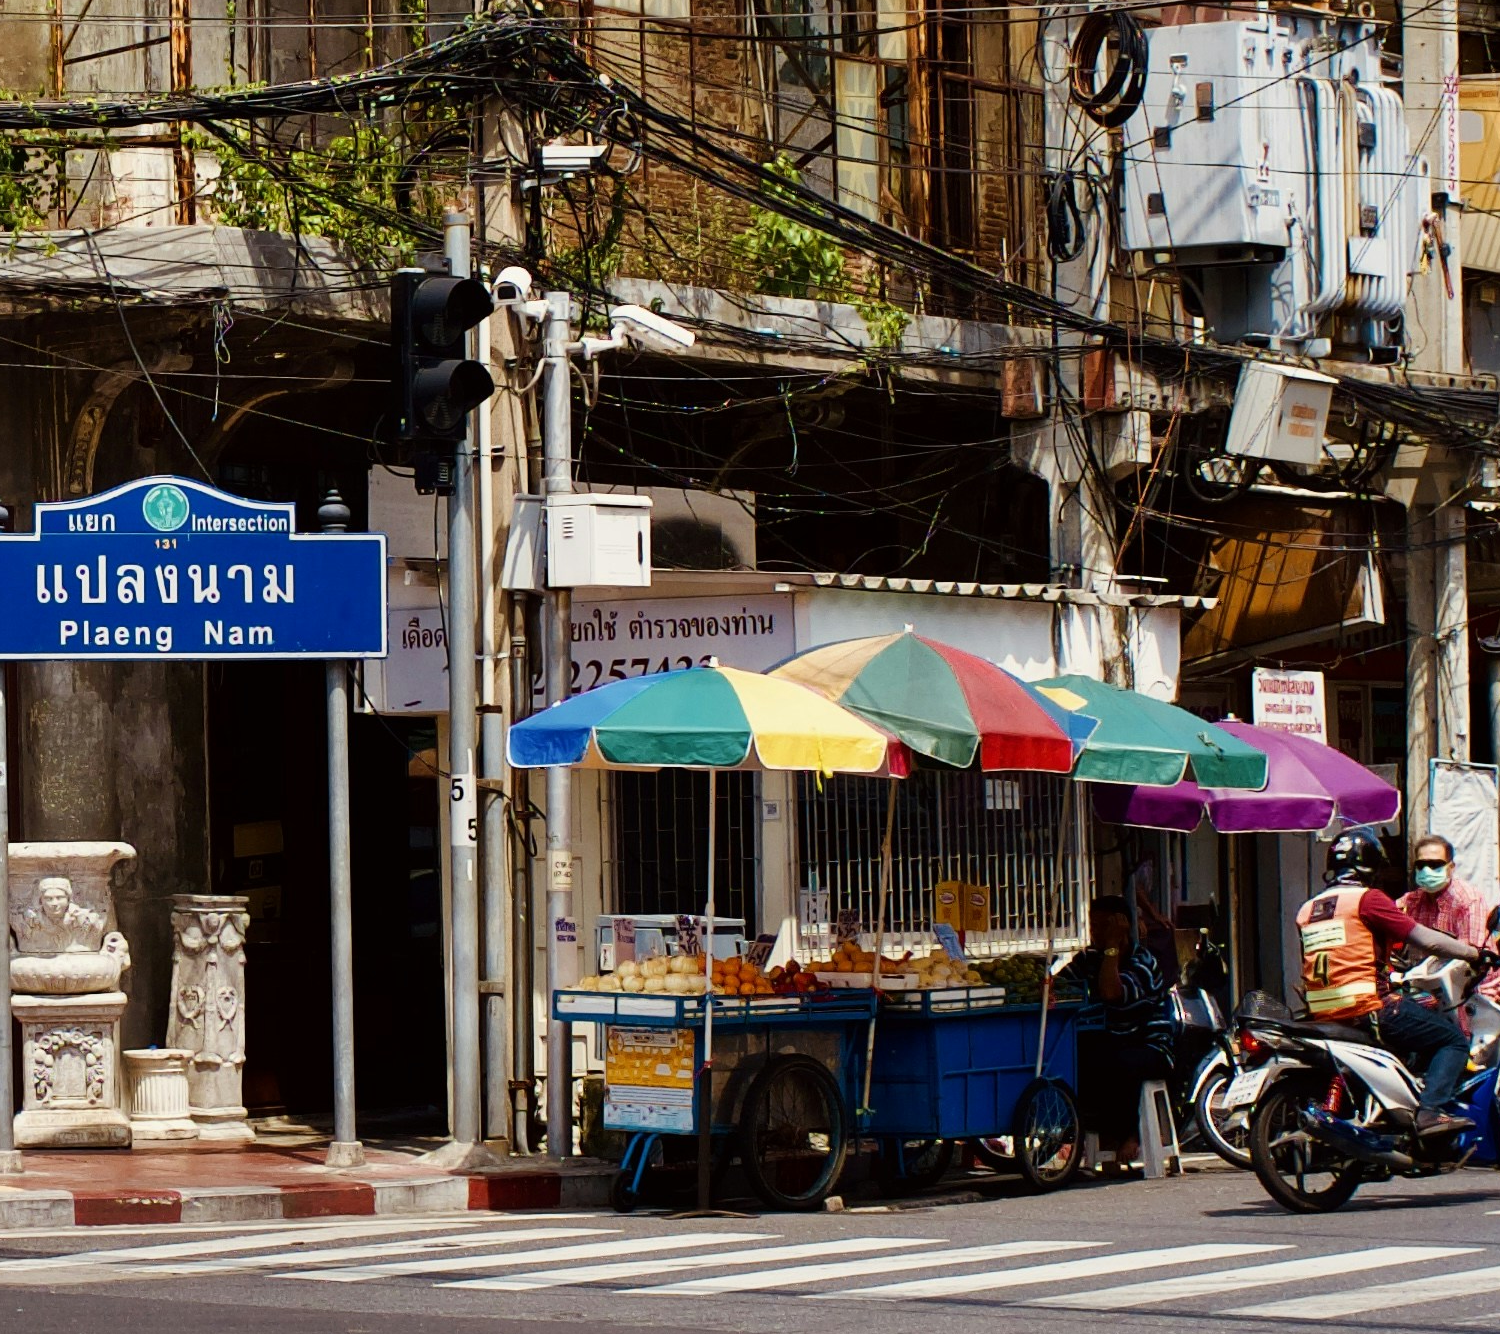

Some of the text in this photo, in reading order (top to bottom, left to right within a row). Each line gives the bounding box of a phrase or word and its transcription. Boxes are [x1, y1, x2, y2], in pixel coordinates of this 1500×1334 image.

[68, 513, 116, 532] แยก
[191, 514, 288, 532] Intersection
[154, 538, 177, 550] 131
[36, 554, 295, 604] แปลงนาม
[60, 620, 274, 652] Plaeng Nam
[402, 606, 774, 650] เดือด ยกใช้ ตำรวจของท่าน
[451, 778, 464, 802] 5
[467, 818, 477, 842] 5
